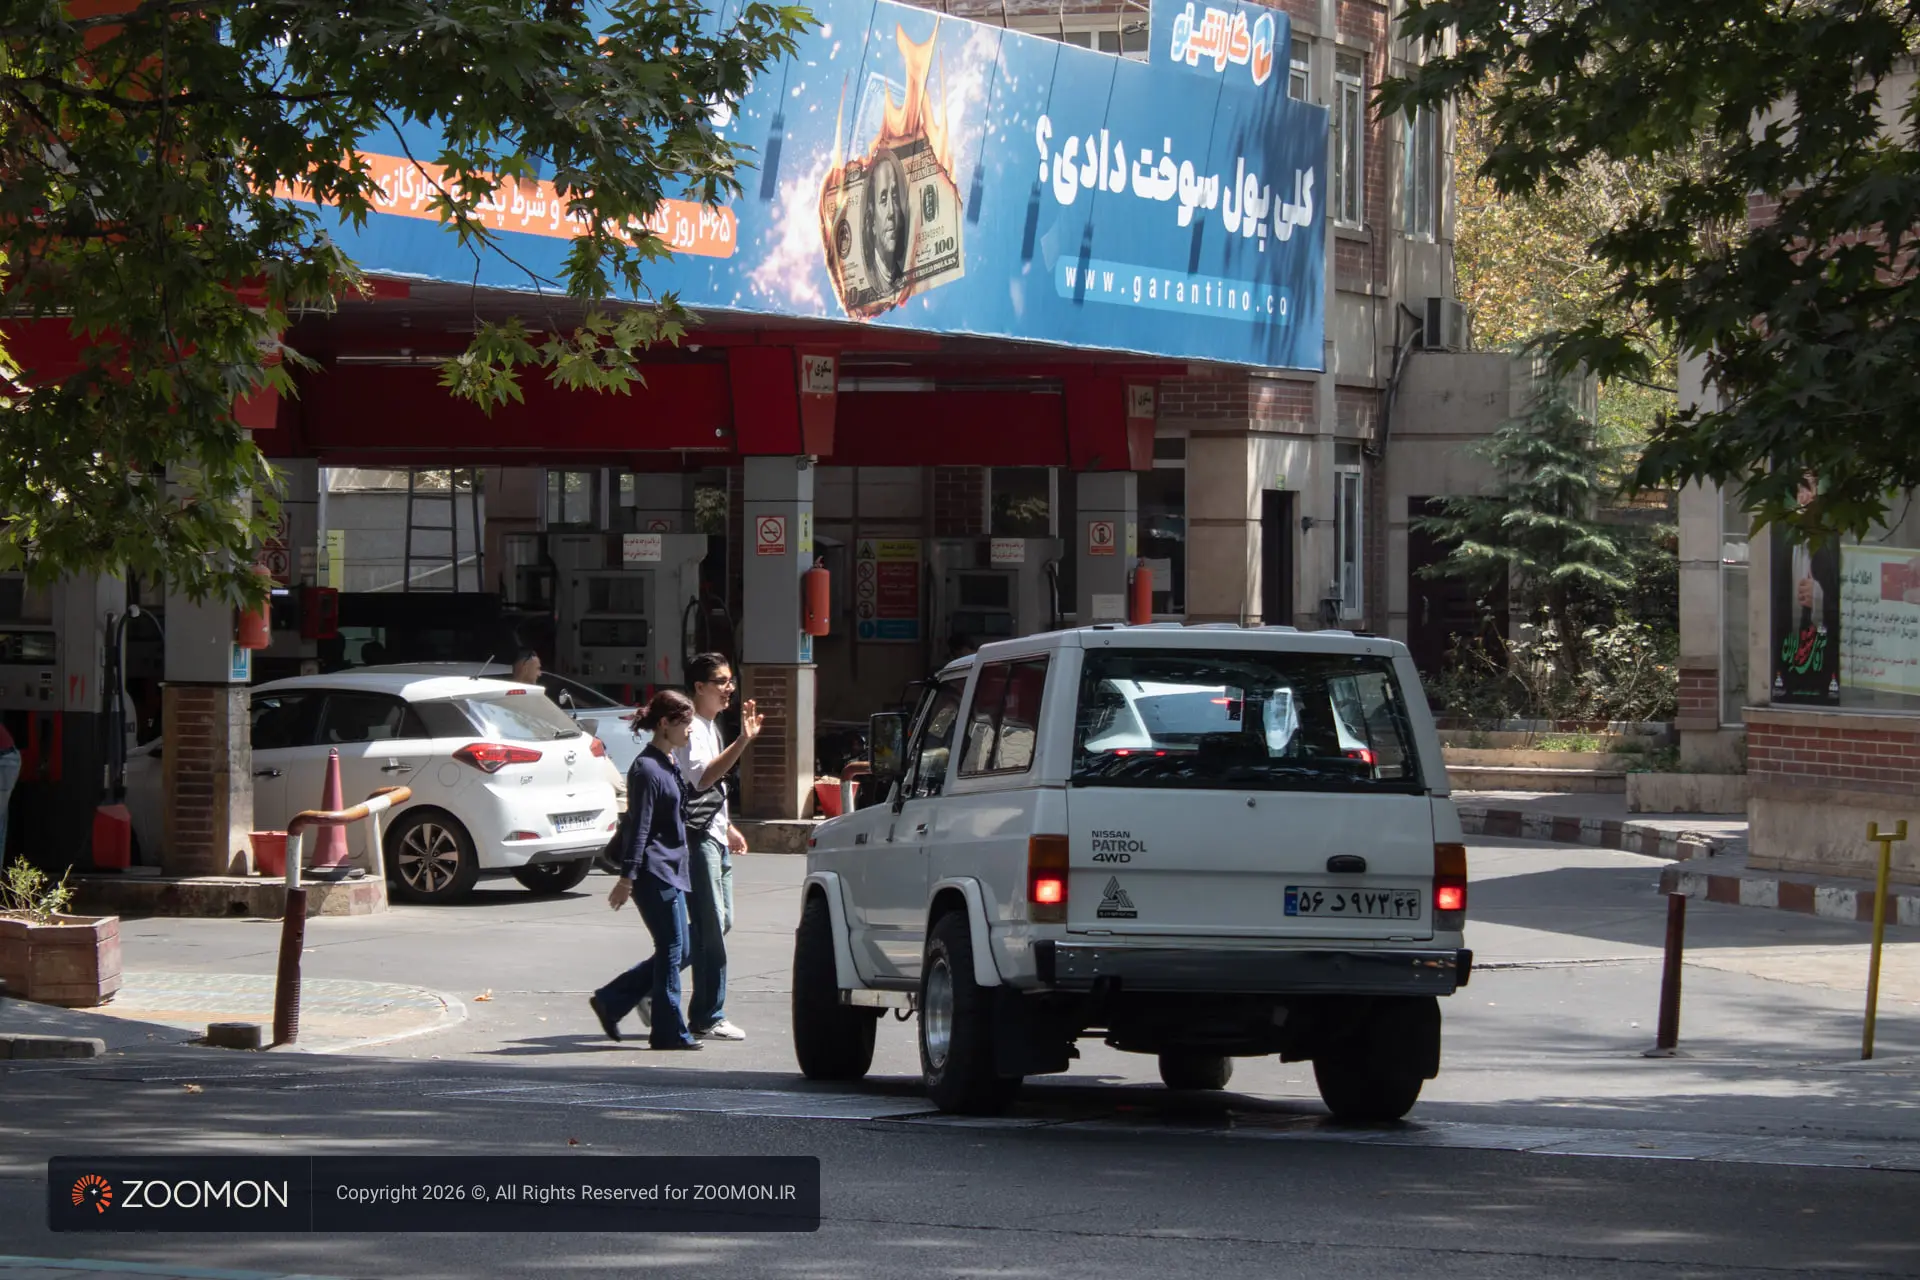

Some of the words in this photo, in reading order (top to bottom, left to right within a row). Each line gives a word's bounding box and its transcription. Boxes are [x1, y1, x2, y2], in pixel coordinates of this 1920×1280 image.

[1035, 114, 1127, 206] دادی؟
[1132, 136, 1219, 227] سوخت
[510, 183, 546, 226] شرط
[549, 199, 560, 230] و
[1222, 156, 1270, 252] پول
[1274, 166, 1314, 241] کلی
[672, 211, 696, 247] روز
[699, 210, 731, 242] ۳۶۵
[1065, 266, 1288, 316] www.garantino.co
[805, 359, 814, 389] ۲
[1091, 830, 1131, 839] NISSAN
[1092, 840, 1148, 852] PATROL
[1092, 853, 1131, 863] 4WD
